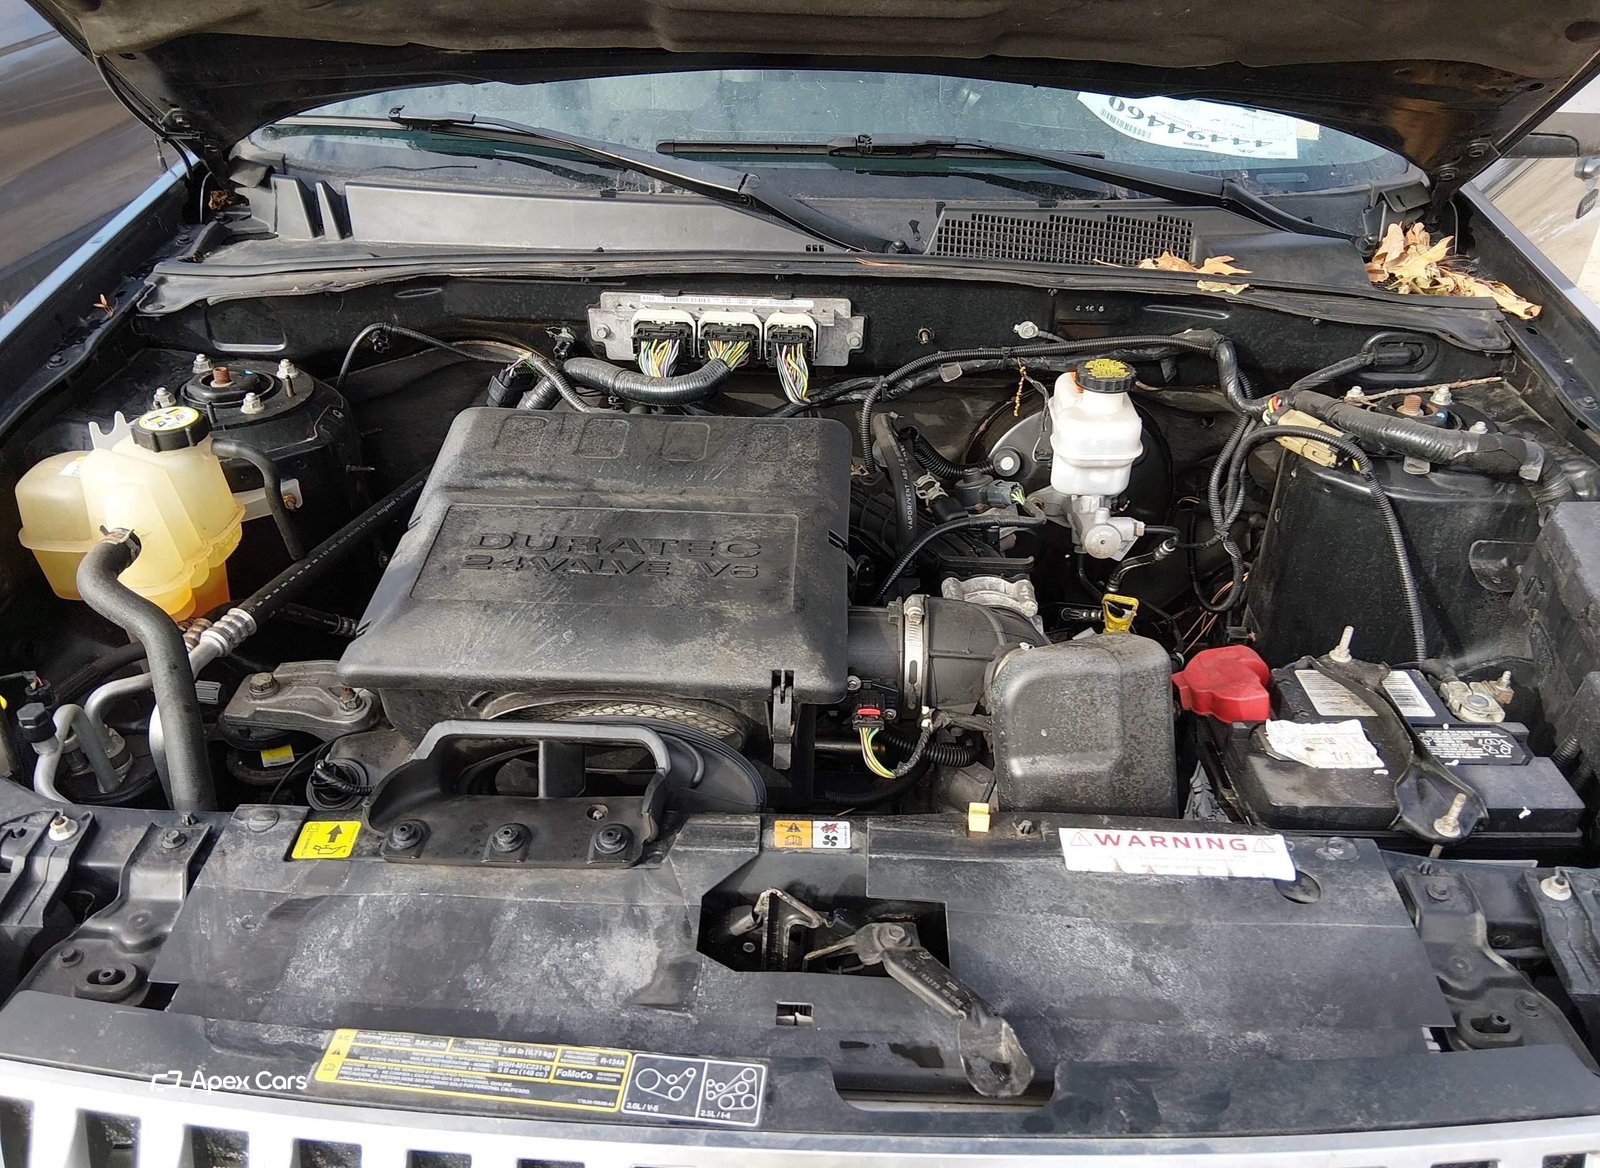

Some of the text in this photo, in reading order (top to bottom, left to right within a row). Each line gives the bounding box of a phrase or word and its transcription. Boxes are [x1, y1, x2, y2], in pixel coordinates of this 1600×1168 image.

[1108, 97, 1273, 148] 44494460
[903, 484, 914, 531] VAPOR/VENT
[469, 532, 762, 560] DURATEC
[697, 562, 760, 580] V6
[1094, 832, 1248, 852] WARNING
[543, 1050, 556, 1058] kg)
[600, 1058, 625, 1066] R-134A
[555, 1068, 594, 1080] FoMoCo
[626, 1102, 641, 1110] 3.0L
